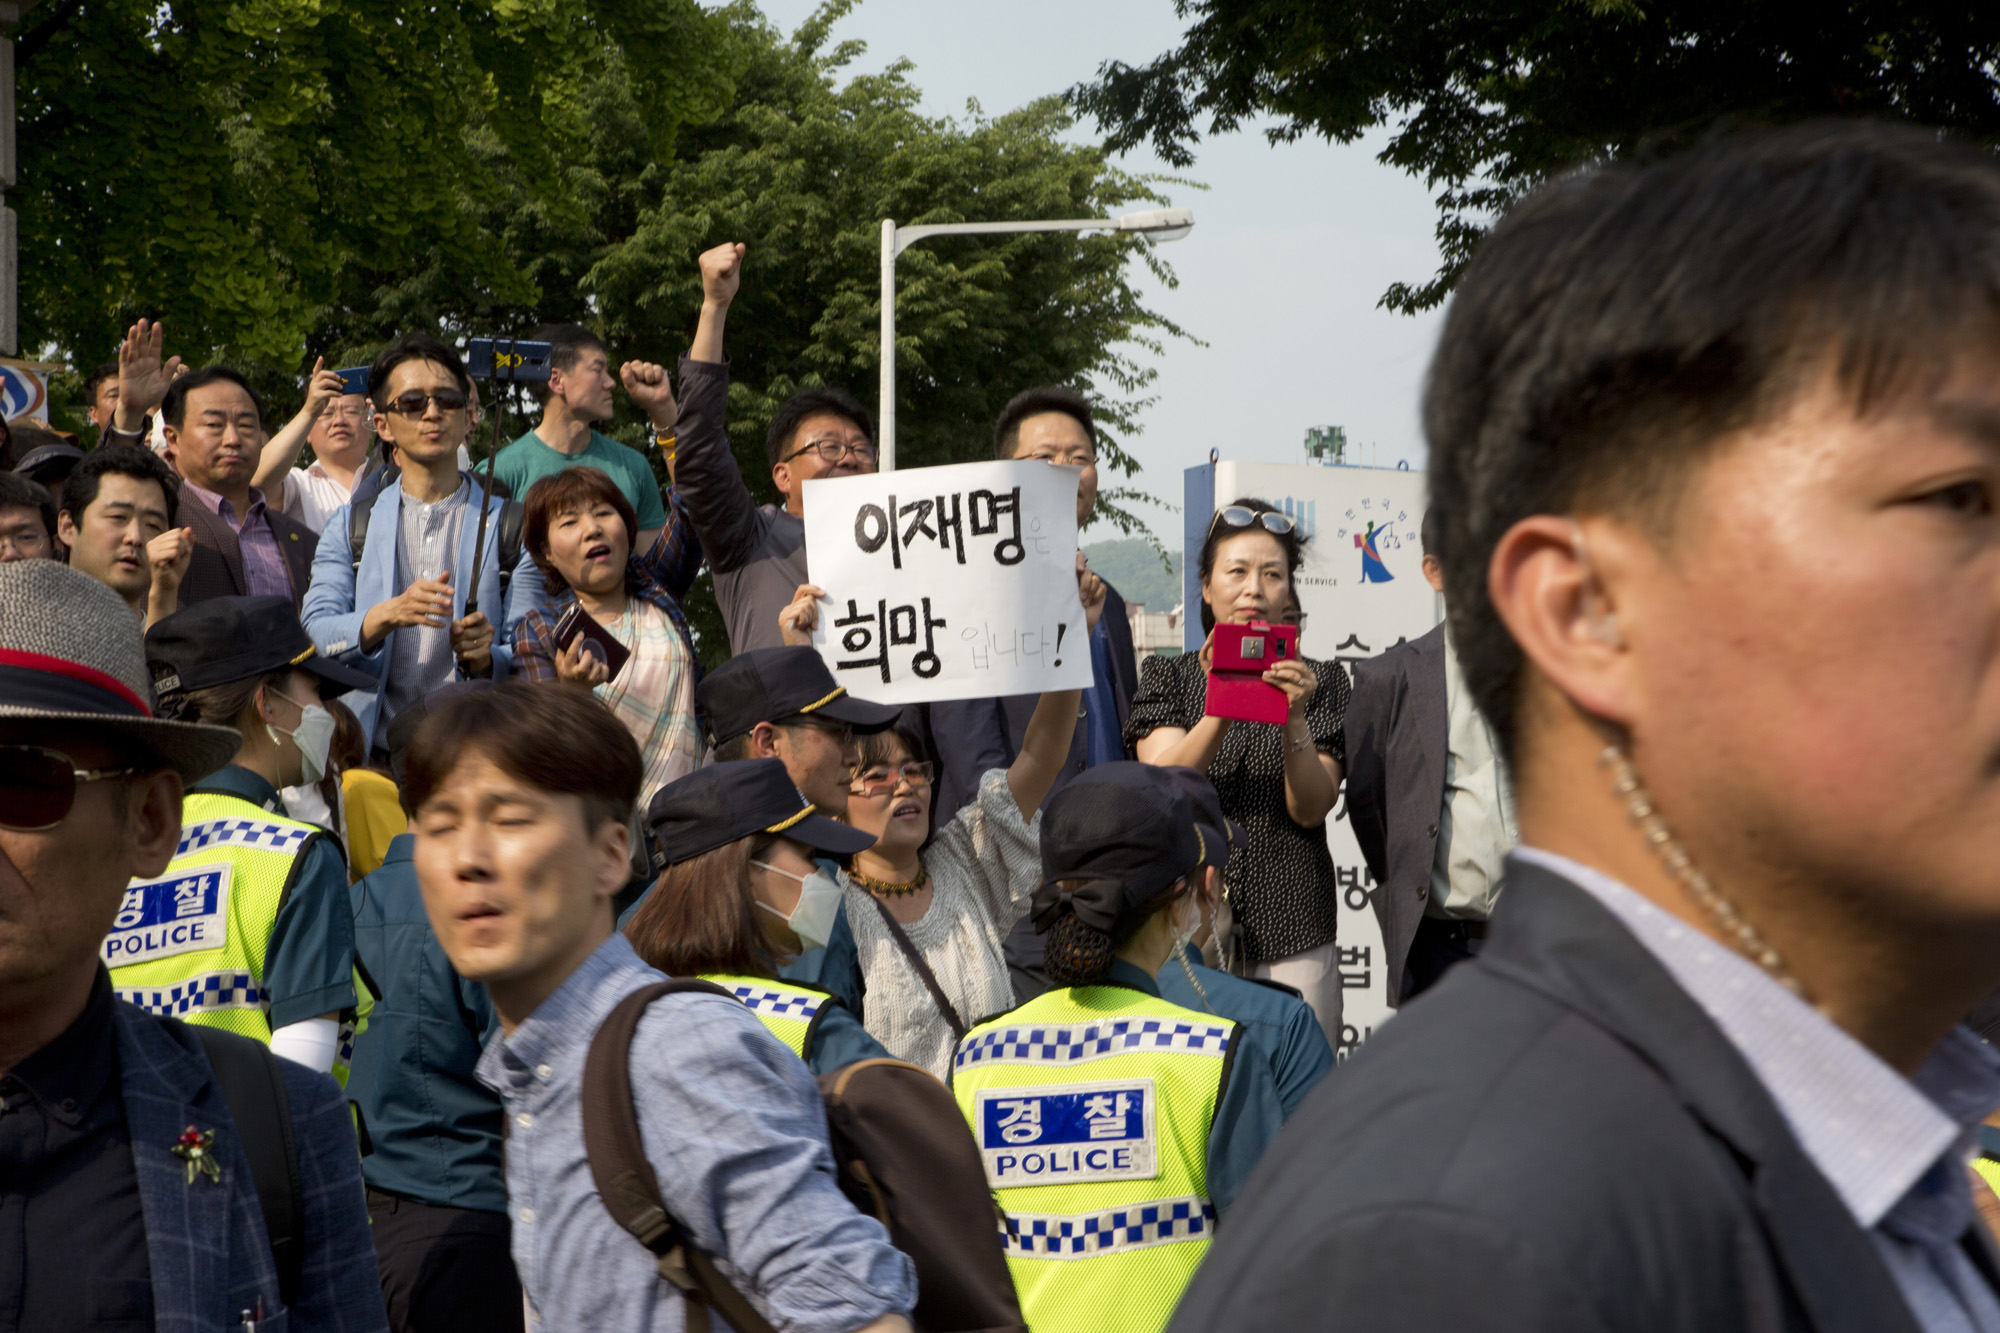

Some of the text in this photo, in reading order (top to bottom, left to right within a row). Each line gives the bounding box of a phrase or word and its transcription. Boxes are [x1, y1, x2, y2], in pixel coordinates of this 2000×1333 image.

[1305, 577, 1338, 587] SERVICE
[156, 676, 178, 692] LICE
[106, 922, 205, 959] POLICE
[996, 1148, 1132, 1176] POLICE
